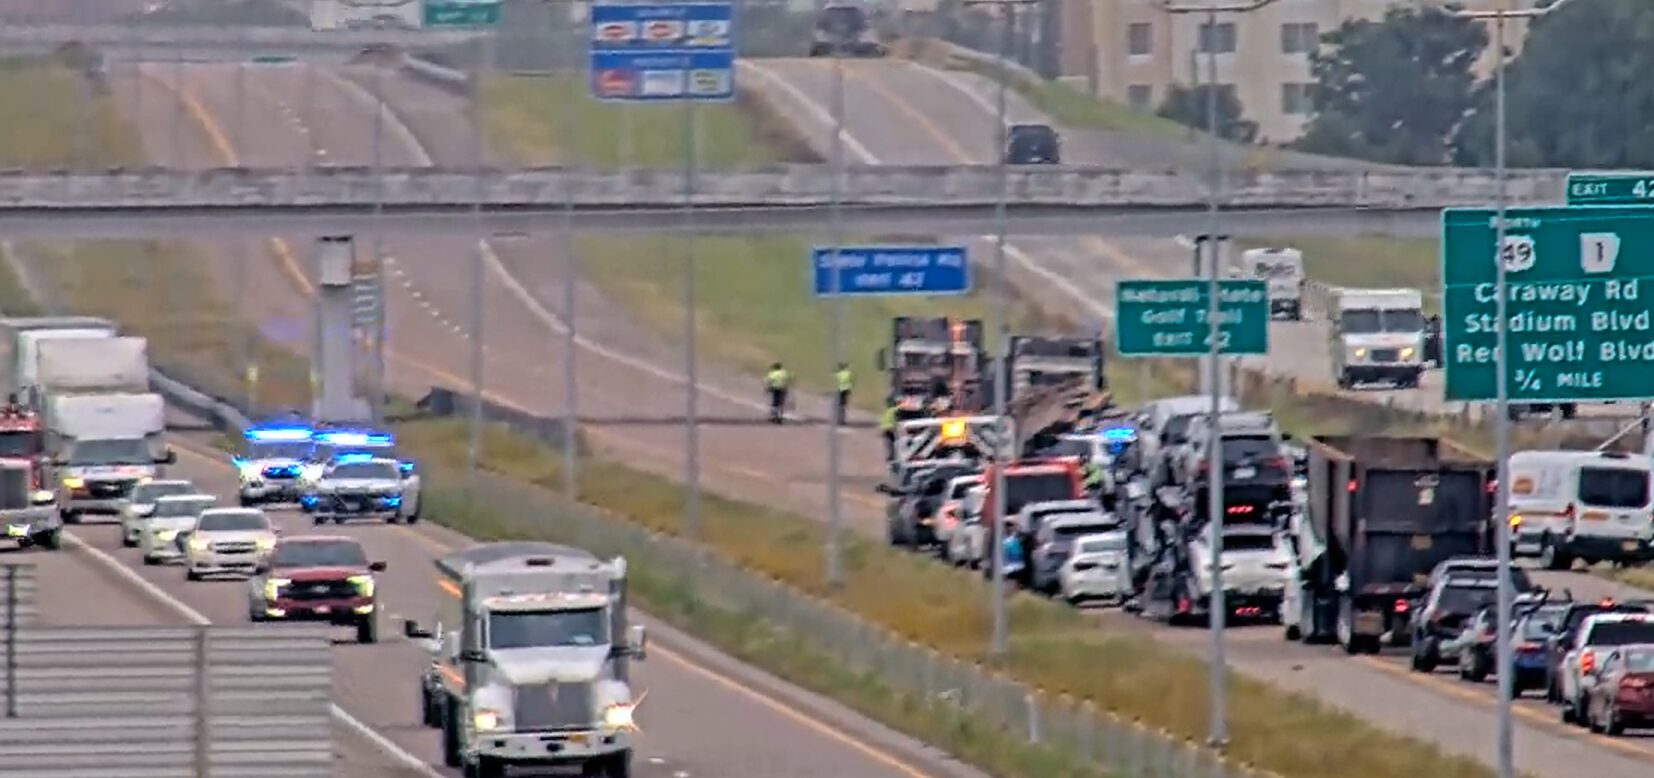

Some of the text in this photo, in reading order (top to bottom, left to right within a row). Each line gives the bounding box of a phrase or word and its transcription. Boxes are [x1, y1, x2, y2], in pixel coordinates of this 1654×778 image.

[1572, 182, 1608, 196] EXIT
[1605, 278, 1638, 300] Rd
[1591, 309, 1650, 332] Blvd
[1521, 340, 1585, 362] Wolf
[1600, 339, 1654, 362] Blvd
[1556, 372, 1603, 389] MILE
